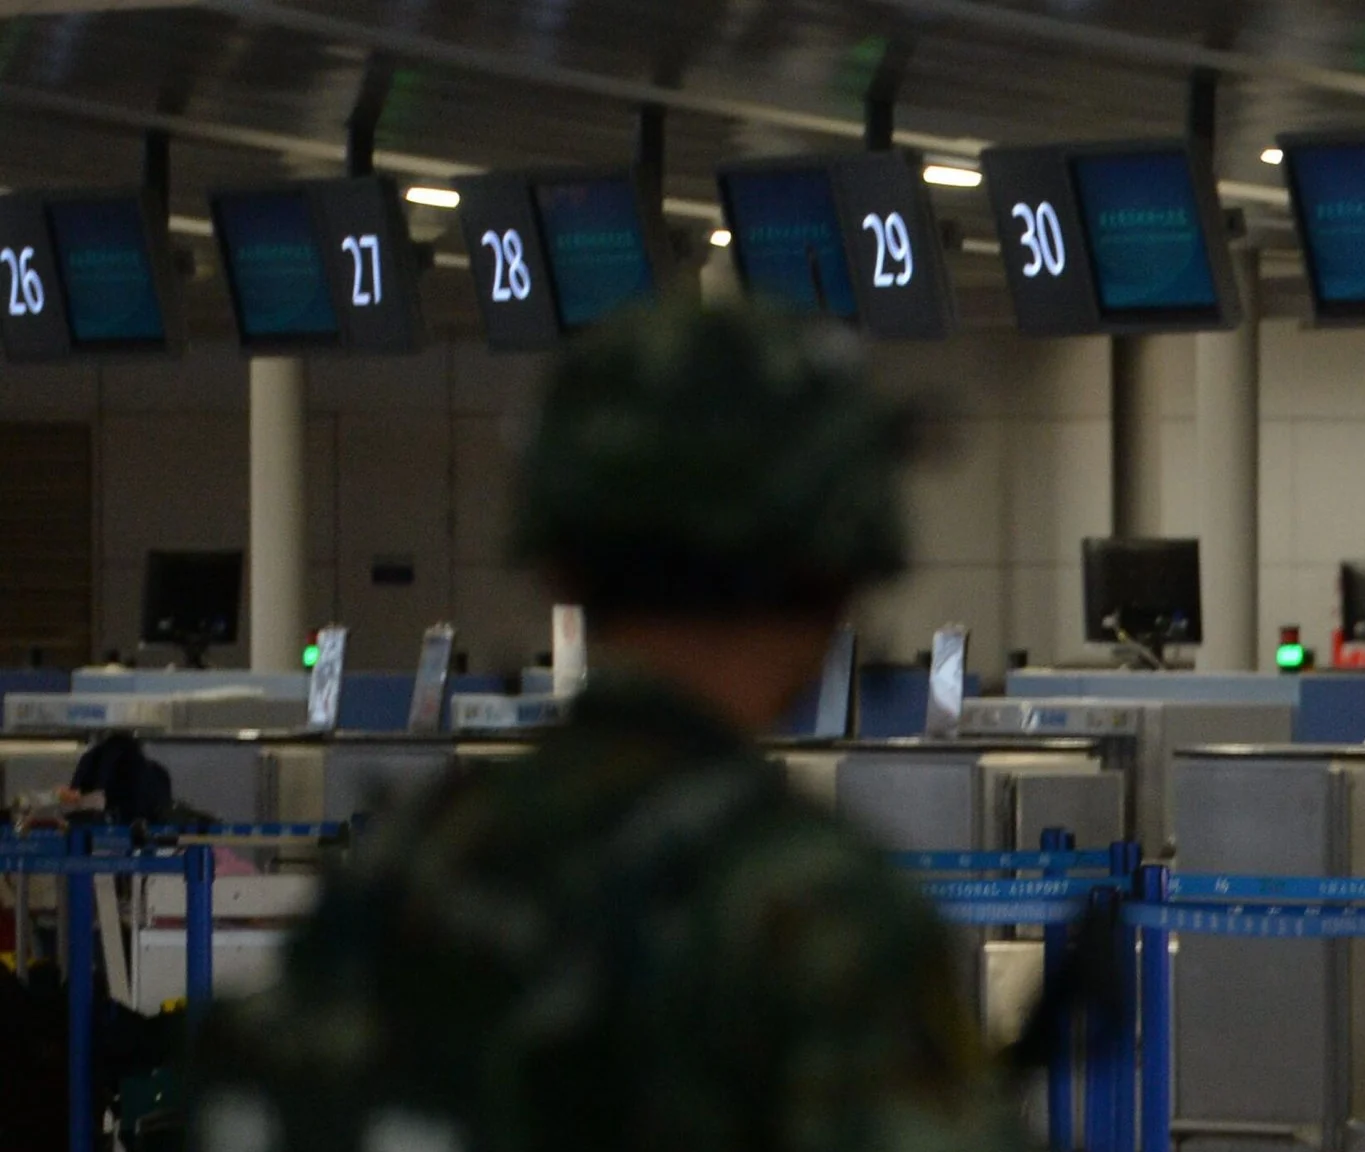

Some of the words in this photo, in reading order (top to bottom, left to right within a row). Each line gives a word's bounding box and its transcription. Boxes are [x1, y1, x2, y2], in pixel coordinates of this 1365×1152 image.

[341, 235, 381, 306] 27
[481, 229, 531, 301] 28
[862, 212, 913, 287] 29
[1011, 201, 1065, 277] 30
[0, 246, 44, 316] 26
